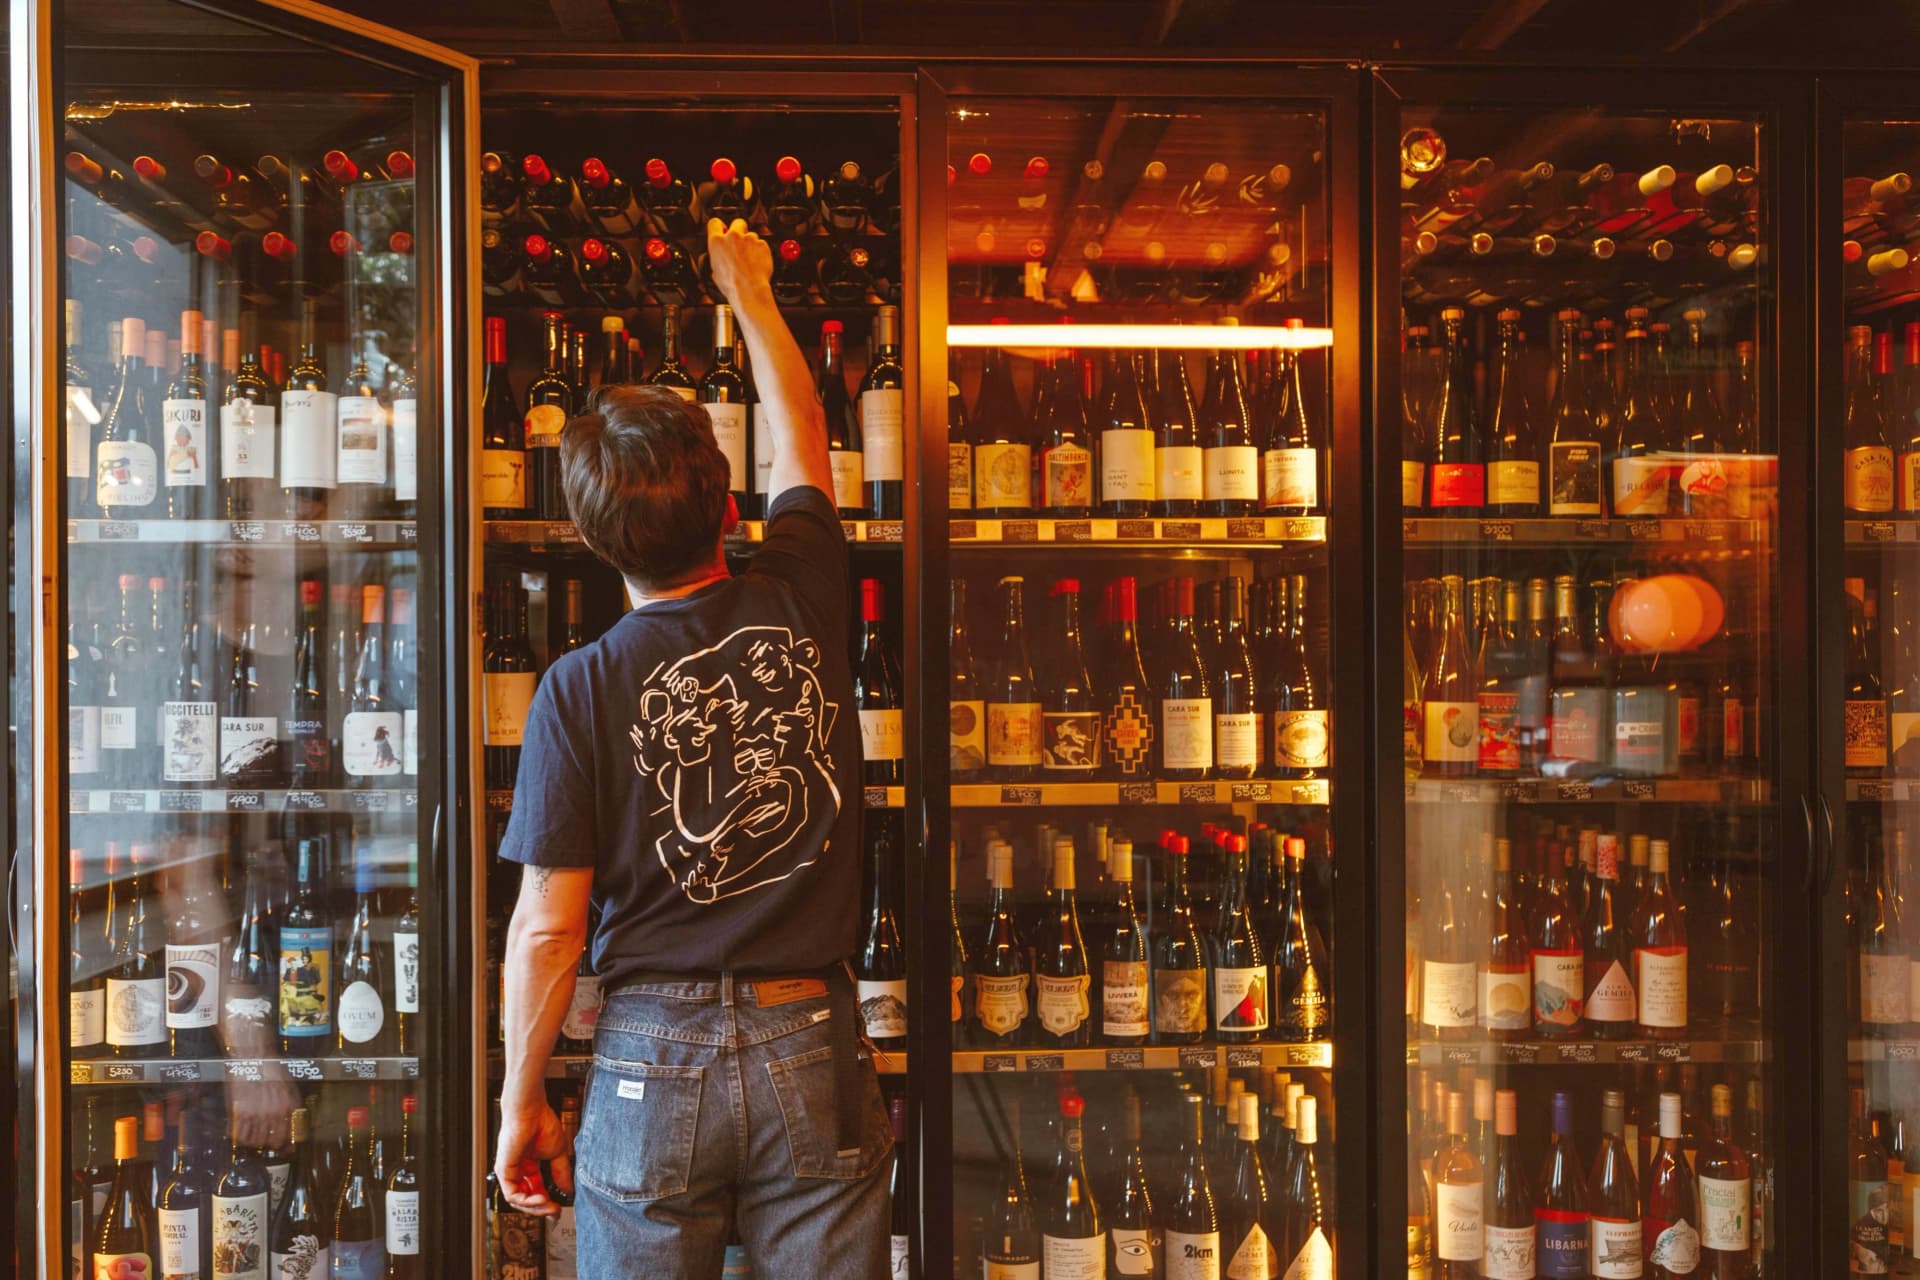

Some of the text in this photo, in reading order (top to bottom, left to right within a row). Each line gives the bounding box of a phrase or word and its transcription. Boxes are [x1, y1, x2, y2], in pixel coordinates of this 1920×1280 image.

[245, 723, 265, 732] SUR
[1545, 1237, 1590, 1250] LIBARNA
[1184, 1244, 1213, 1259] 2km
